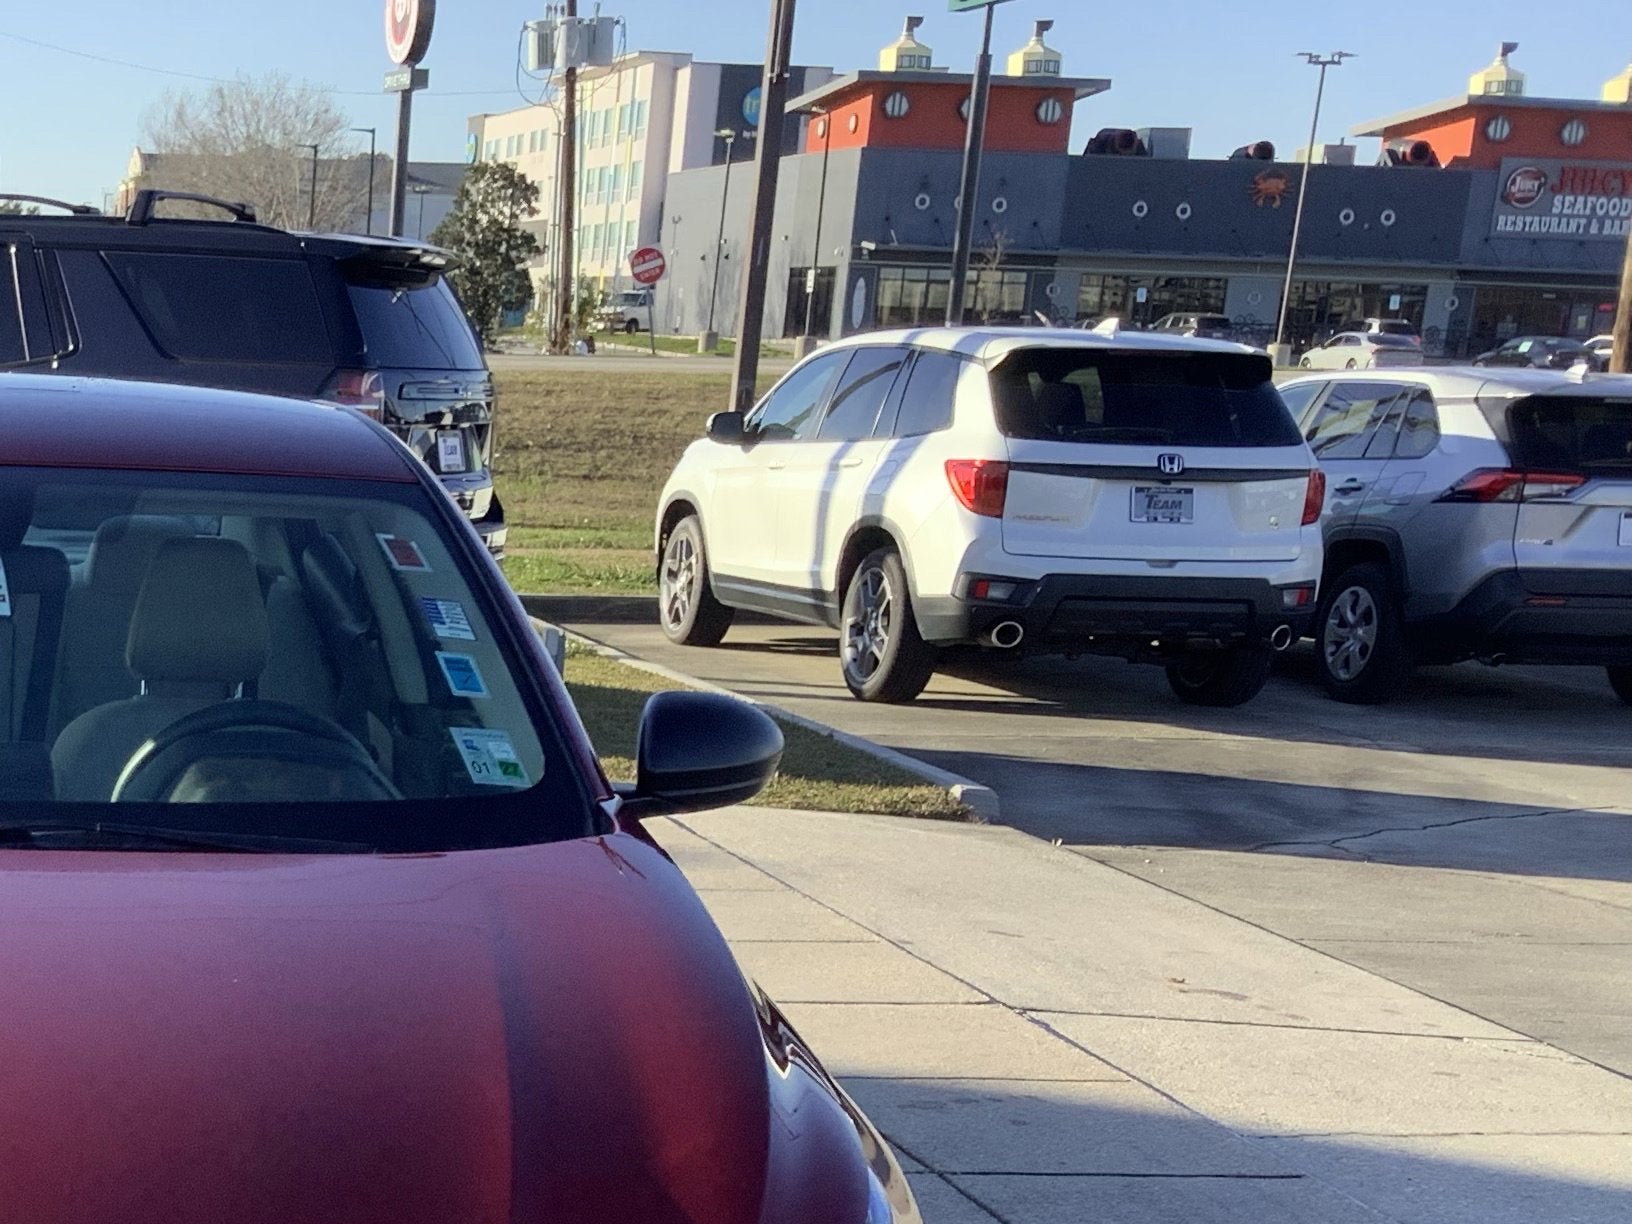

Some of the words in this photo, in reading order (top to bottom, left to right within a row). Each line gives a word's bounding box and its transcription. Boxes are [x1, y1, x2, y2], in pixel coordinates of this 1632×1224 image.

[1552, 195, 1632, 217] SEAFOOD
[1496, 215, 1587, 234] RESTAURANT
[1590, 220, 1600, 234] &
[472, 760, 491, 775] 01
